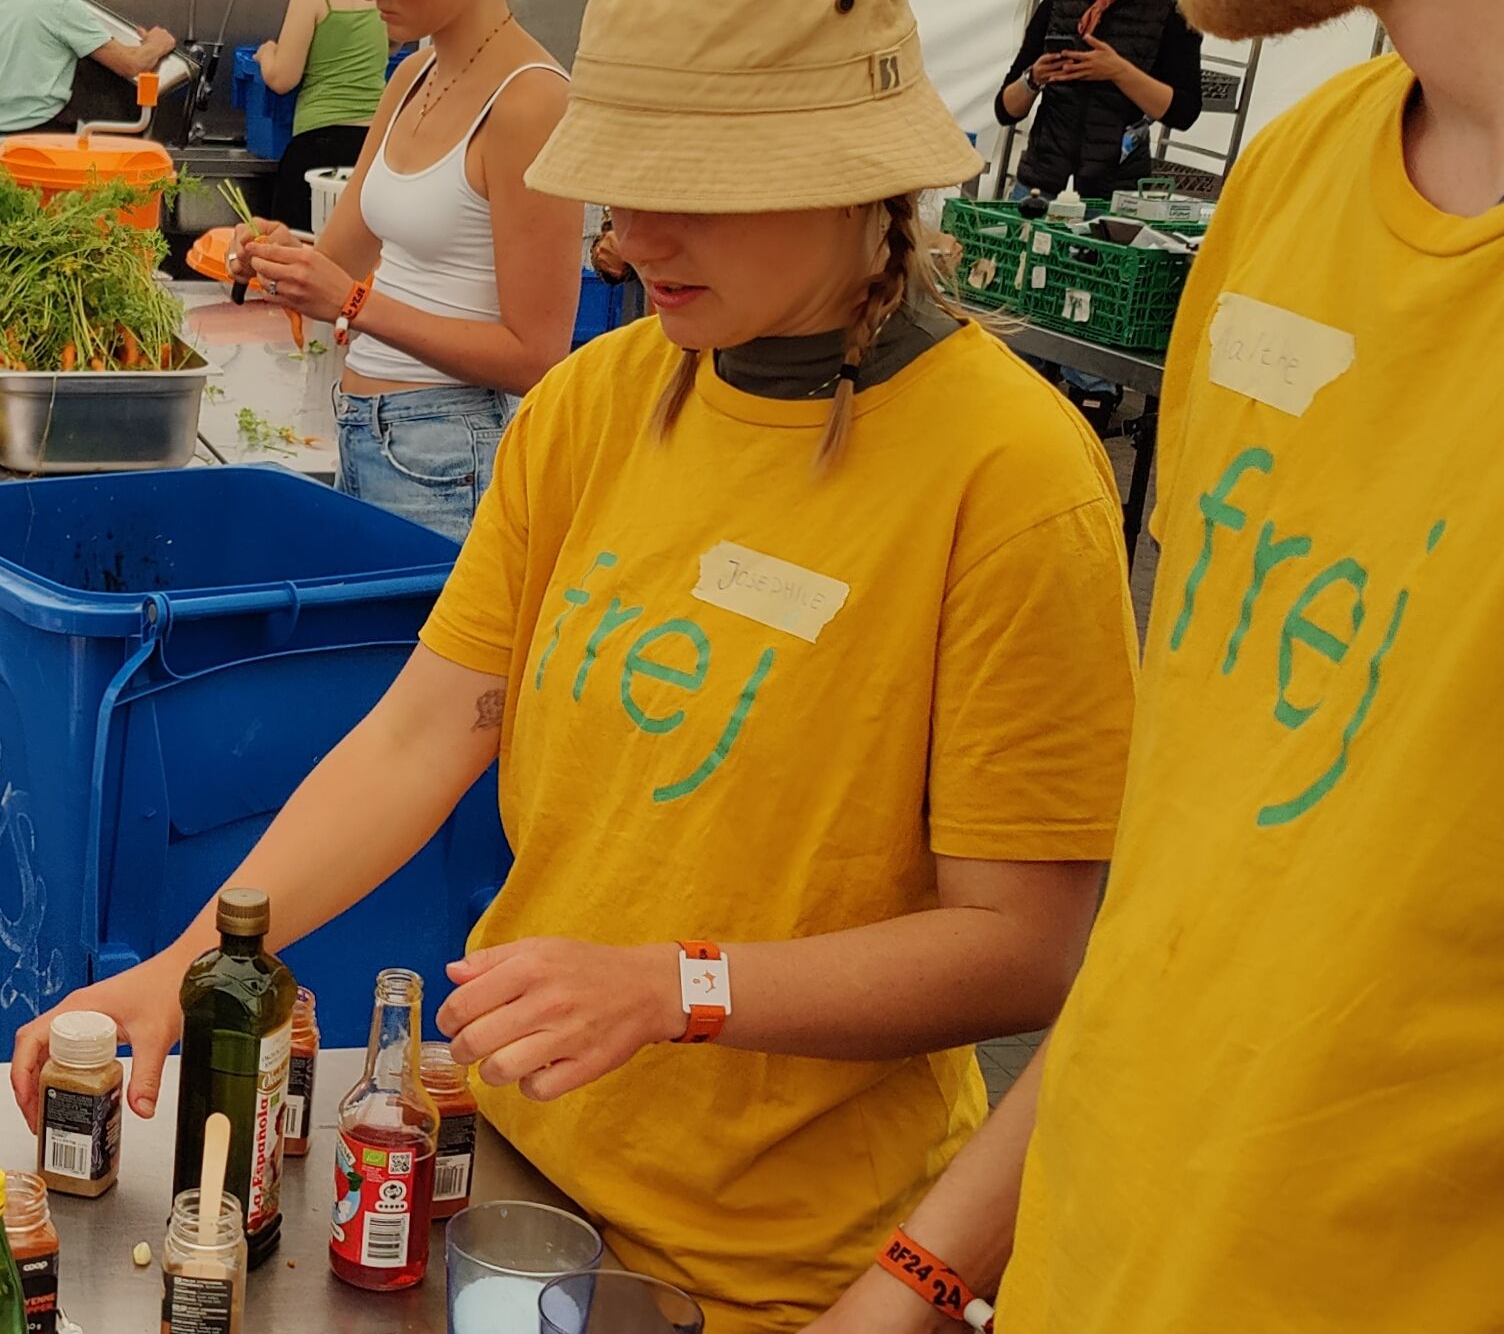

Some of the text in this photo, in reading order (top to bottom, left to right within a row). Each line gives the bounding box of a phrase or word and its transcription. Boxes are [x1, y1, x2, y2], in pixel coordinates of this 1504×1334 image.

[1169, 448, 1445, 826] frej
[249, 1097, 270, 1220] La Española
[23, 1260, 48, 1271] coop
[26, 1292, 56, 1305] YENNE
[886, 1241, 961, 1310] RF24 24
